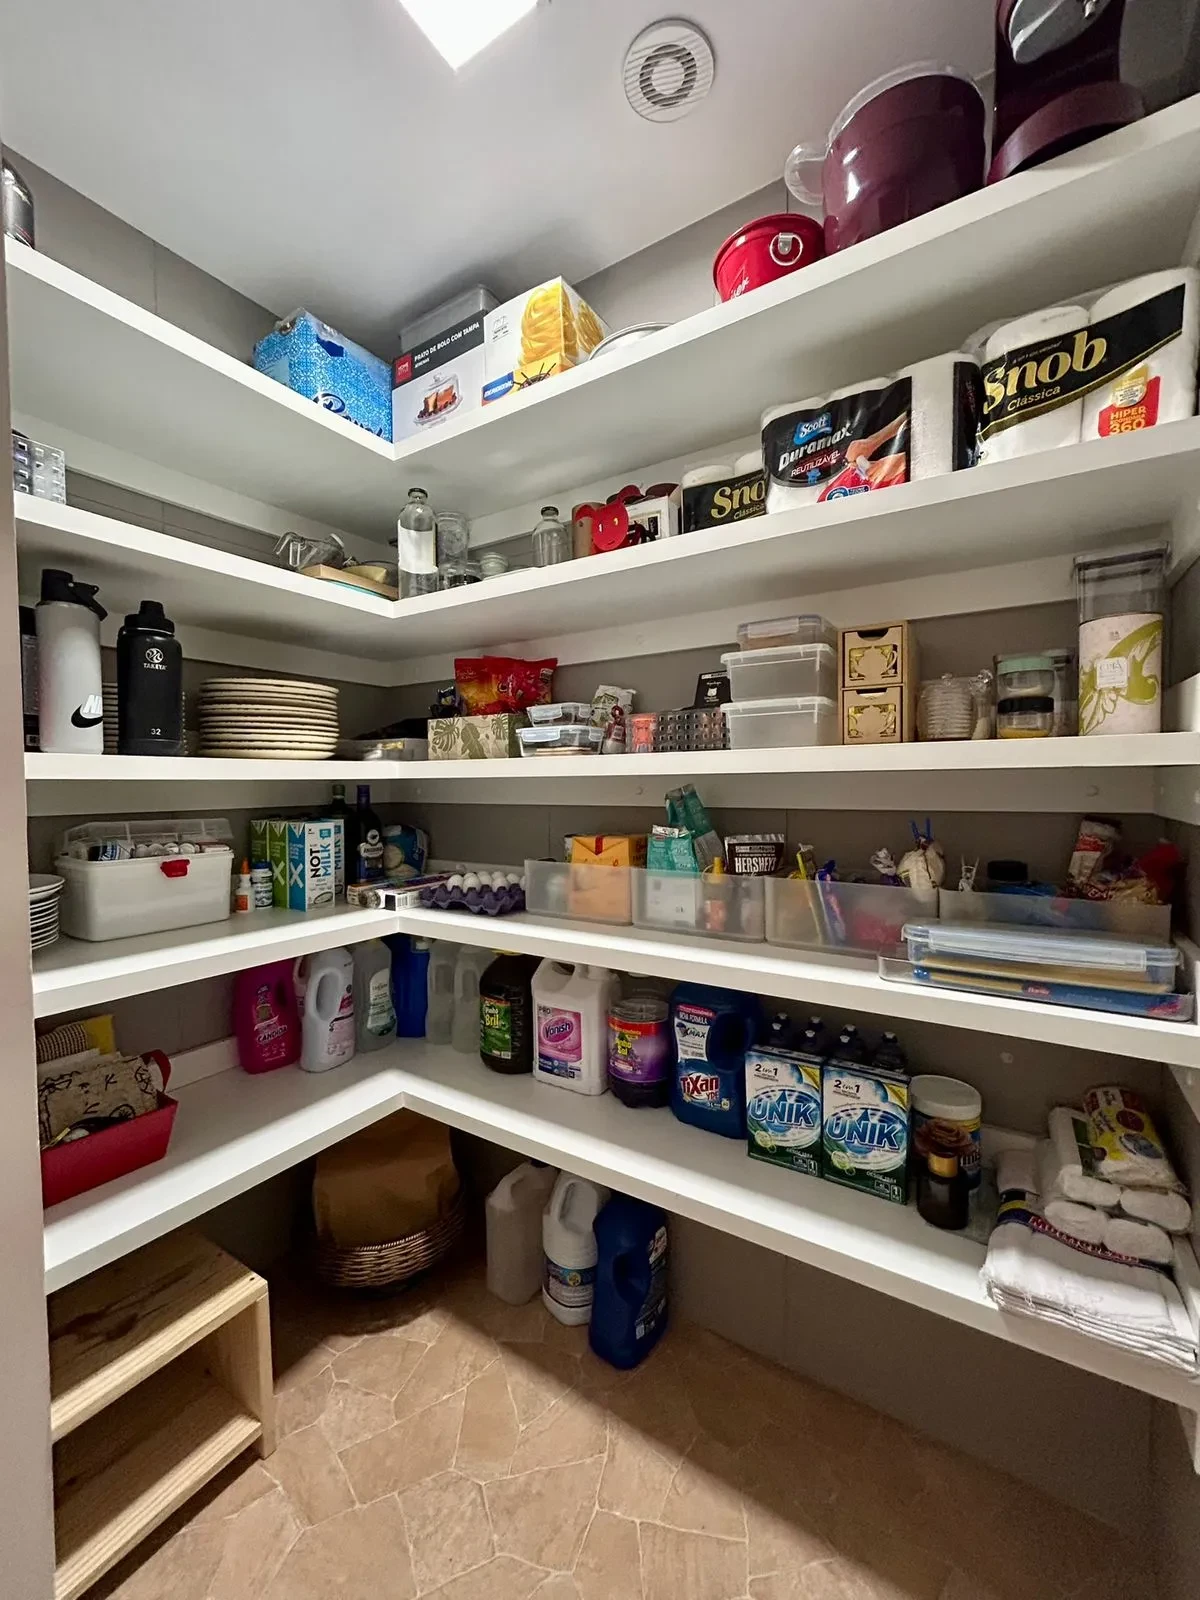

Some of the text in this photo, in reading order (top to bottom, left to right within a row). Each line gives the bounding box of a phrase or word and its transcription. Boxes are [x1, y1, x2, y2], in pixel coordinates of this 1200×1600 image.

[414, 349, 429, 362] PRATO
[429, 345, 437, 354] DE
[437, 337, 451, 350] BOLO
[450, 331, 462, 342] COM
[462, 321, 480, 335] TAMPA
[983, 330, 1107, 415] Snob
[1007, 386, 1061, 411] Clássica
[1110, 405, 1147, 420] HIPER
[799, 415, 828, 438] Scott
[1109, 419, 1146, 435] 360
[778, 423, 853, 472] Duramax
[790, 450, 841, 478] REUTILIZÁVEL
[710, 478, 767, 520] Sno
[143, 662, 166, 671] TAKEYA
[82, 694, 103, 715] NI
[150, 728, 162, 736] 32
[309, 848, 321, 879] NOT
[320, 843, 332, 878] MILK
[334, 839, 342, 870] MILK
[485, 1014, 499, 1027] Bril
[538, 1005, 551, 1015] PRO
[545, 1020, 572, 1039] Vanish
[755, 1063, 762, 1073] 2
[772, 1068, 779, 1076] 1
[833, 1079, 842, 1089] 2
[854, 1084, 861, 1094] 1
[749, 1098, 815, 1128] UNIK
[826, 1114, 901, 1150] UNIK
